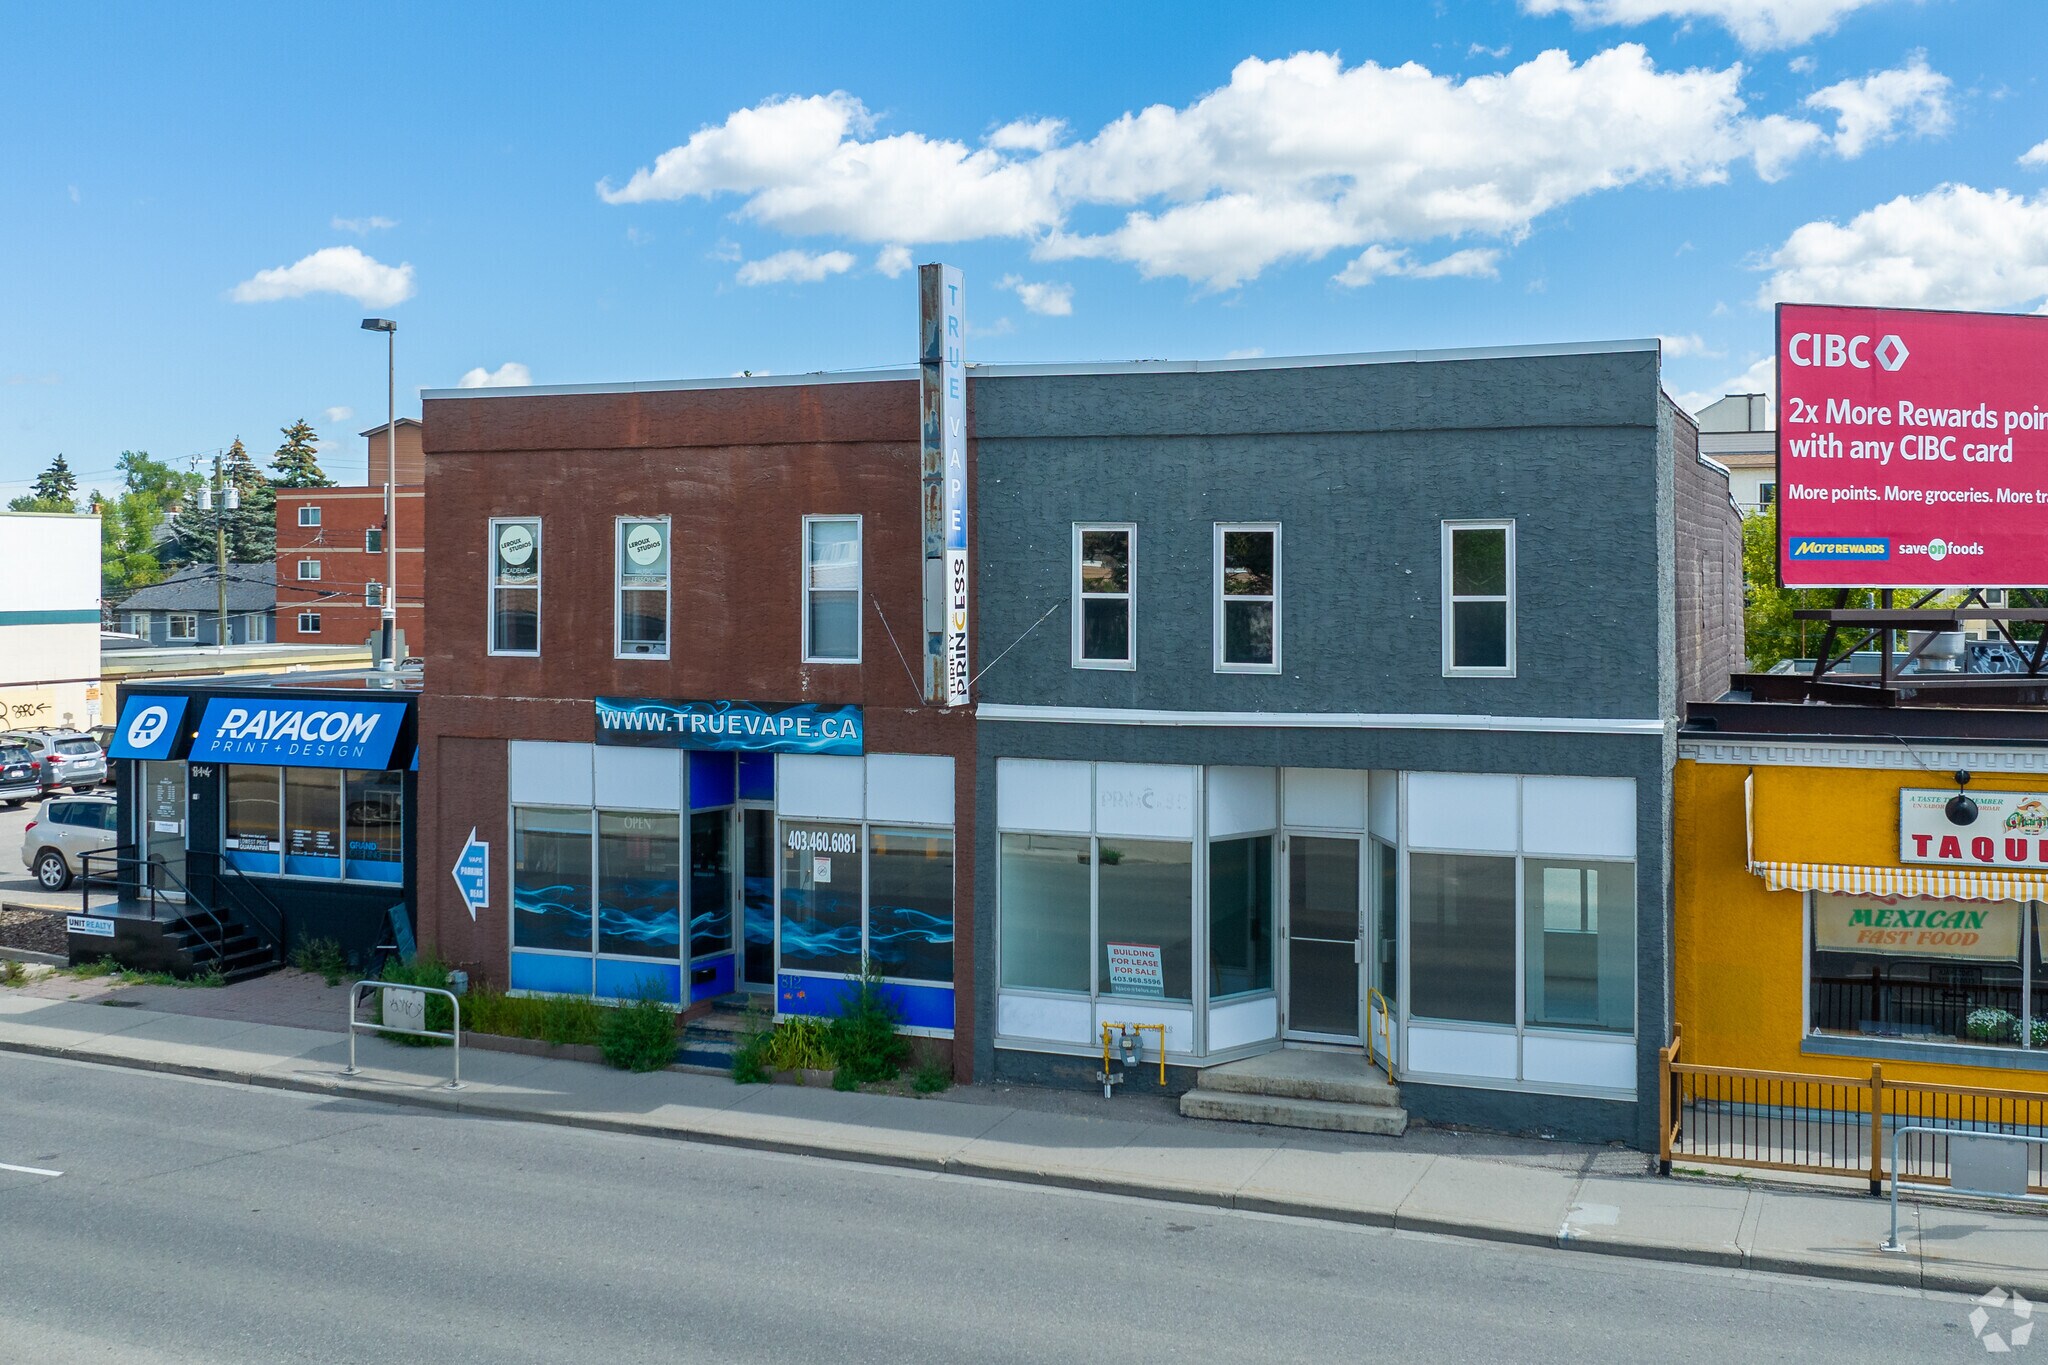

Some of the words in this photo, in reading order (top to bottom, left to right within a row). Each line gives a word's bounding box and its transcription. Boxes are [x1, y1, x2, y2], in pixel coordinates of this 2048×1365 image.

[948, 284, 960, 400] TRUE
[1788, 332, 1871, 369] CIBC
[1789, 397, 1819, 424] 2x
[1825, 398, 1892, 425] More
[1898, 400, 1998, 430] Rewards
[1789, 432, 1843, 458] with
[1850, 440, 1894, 465] any
[1900, 434, 1957, 461] CIBC
[1962, 437, 2013, 463] card
[949, 416, 961, 531] VAPE
[1789, 484, 1828, 500] More
[1831, 485, 1881, 504] points.
[1884, 485, 1922, 501] More
[1925, 487, 1993, 505] groceries.
[1996, 488, 2033, 503] More
[500, 538, 522, 549] LEROUX
[509, 541, 532, 553] STUDIOS
[628, 537, 650, 549] LEROUX
[637, 541, 661, 553] STUDIOS
[954, 558, 967, 696] PRINCESS
[216, 708, 381, 744] RAYACOM
[601, 710, 859, 739] WWW.TRUEVAPE.CA
[210, 741, 270, 754] PRINT
[288, 743, 364, 758] DESIGN
[624, 816, 652, 830] OPEN
[349, 841, 377, 851] GRAND
[788, 830, 856, 853] 403.460.6081
[1848, 909, 1989, 930] MEXICAN
[1857, 930, 1913, 945] FAST
[1916, 931, 1980, 946] FOOD
[1111, 957, 1129, 965] FOR
[1131, 959, 1159, 967] LEASE
[1113, 949, 1155, 957] BUILDING
[1114, 966, 1133, 974] FOR
[1135, 968, 1157, 976] SALE
